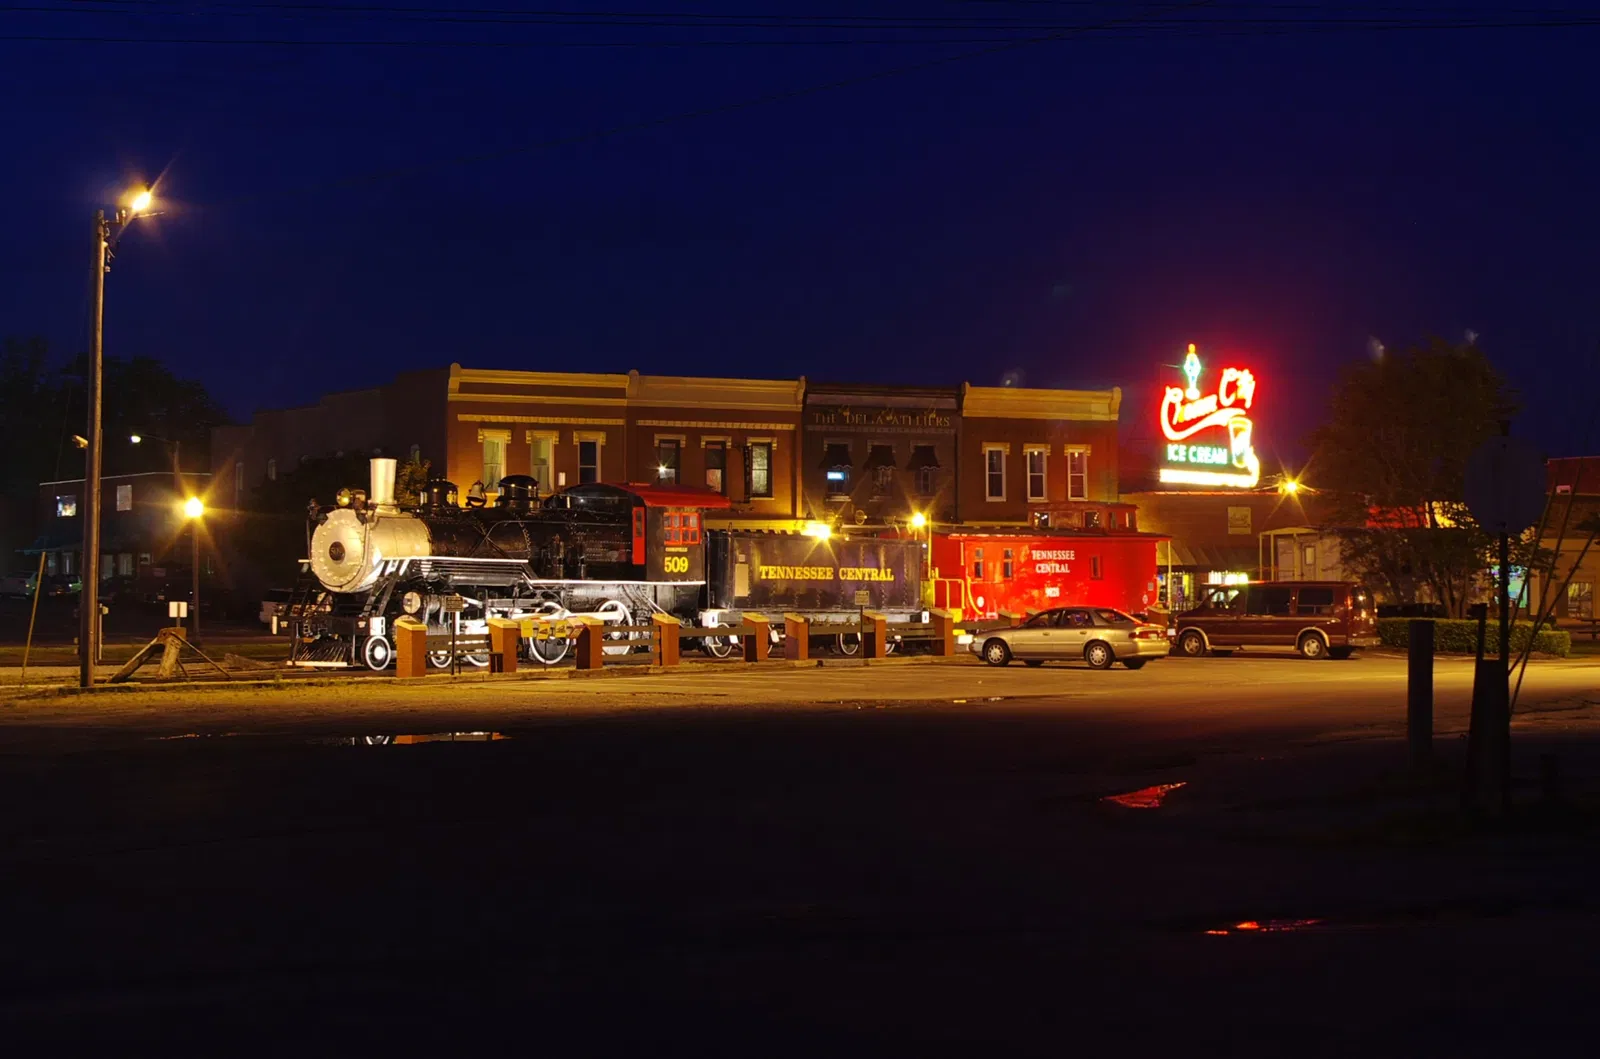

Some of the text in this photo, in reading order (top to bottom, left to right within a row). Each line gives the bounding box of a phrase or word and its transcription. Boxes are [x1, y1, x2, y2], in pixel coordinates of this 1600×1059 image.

[1167, 444, 1228, 465] ICE CREAM
[1031, 550, 1075, 560] TENNESSEE
[664, 556, 689, 573] 509
[1036, 563, 1070, 573] CENTRAL
[759, 565, 894, 581] TENNESSEE CENTRAL
